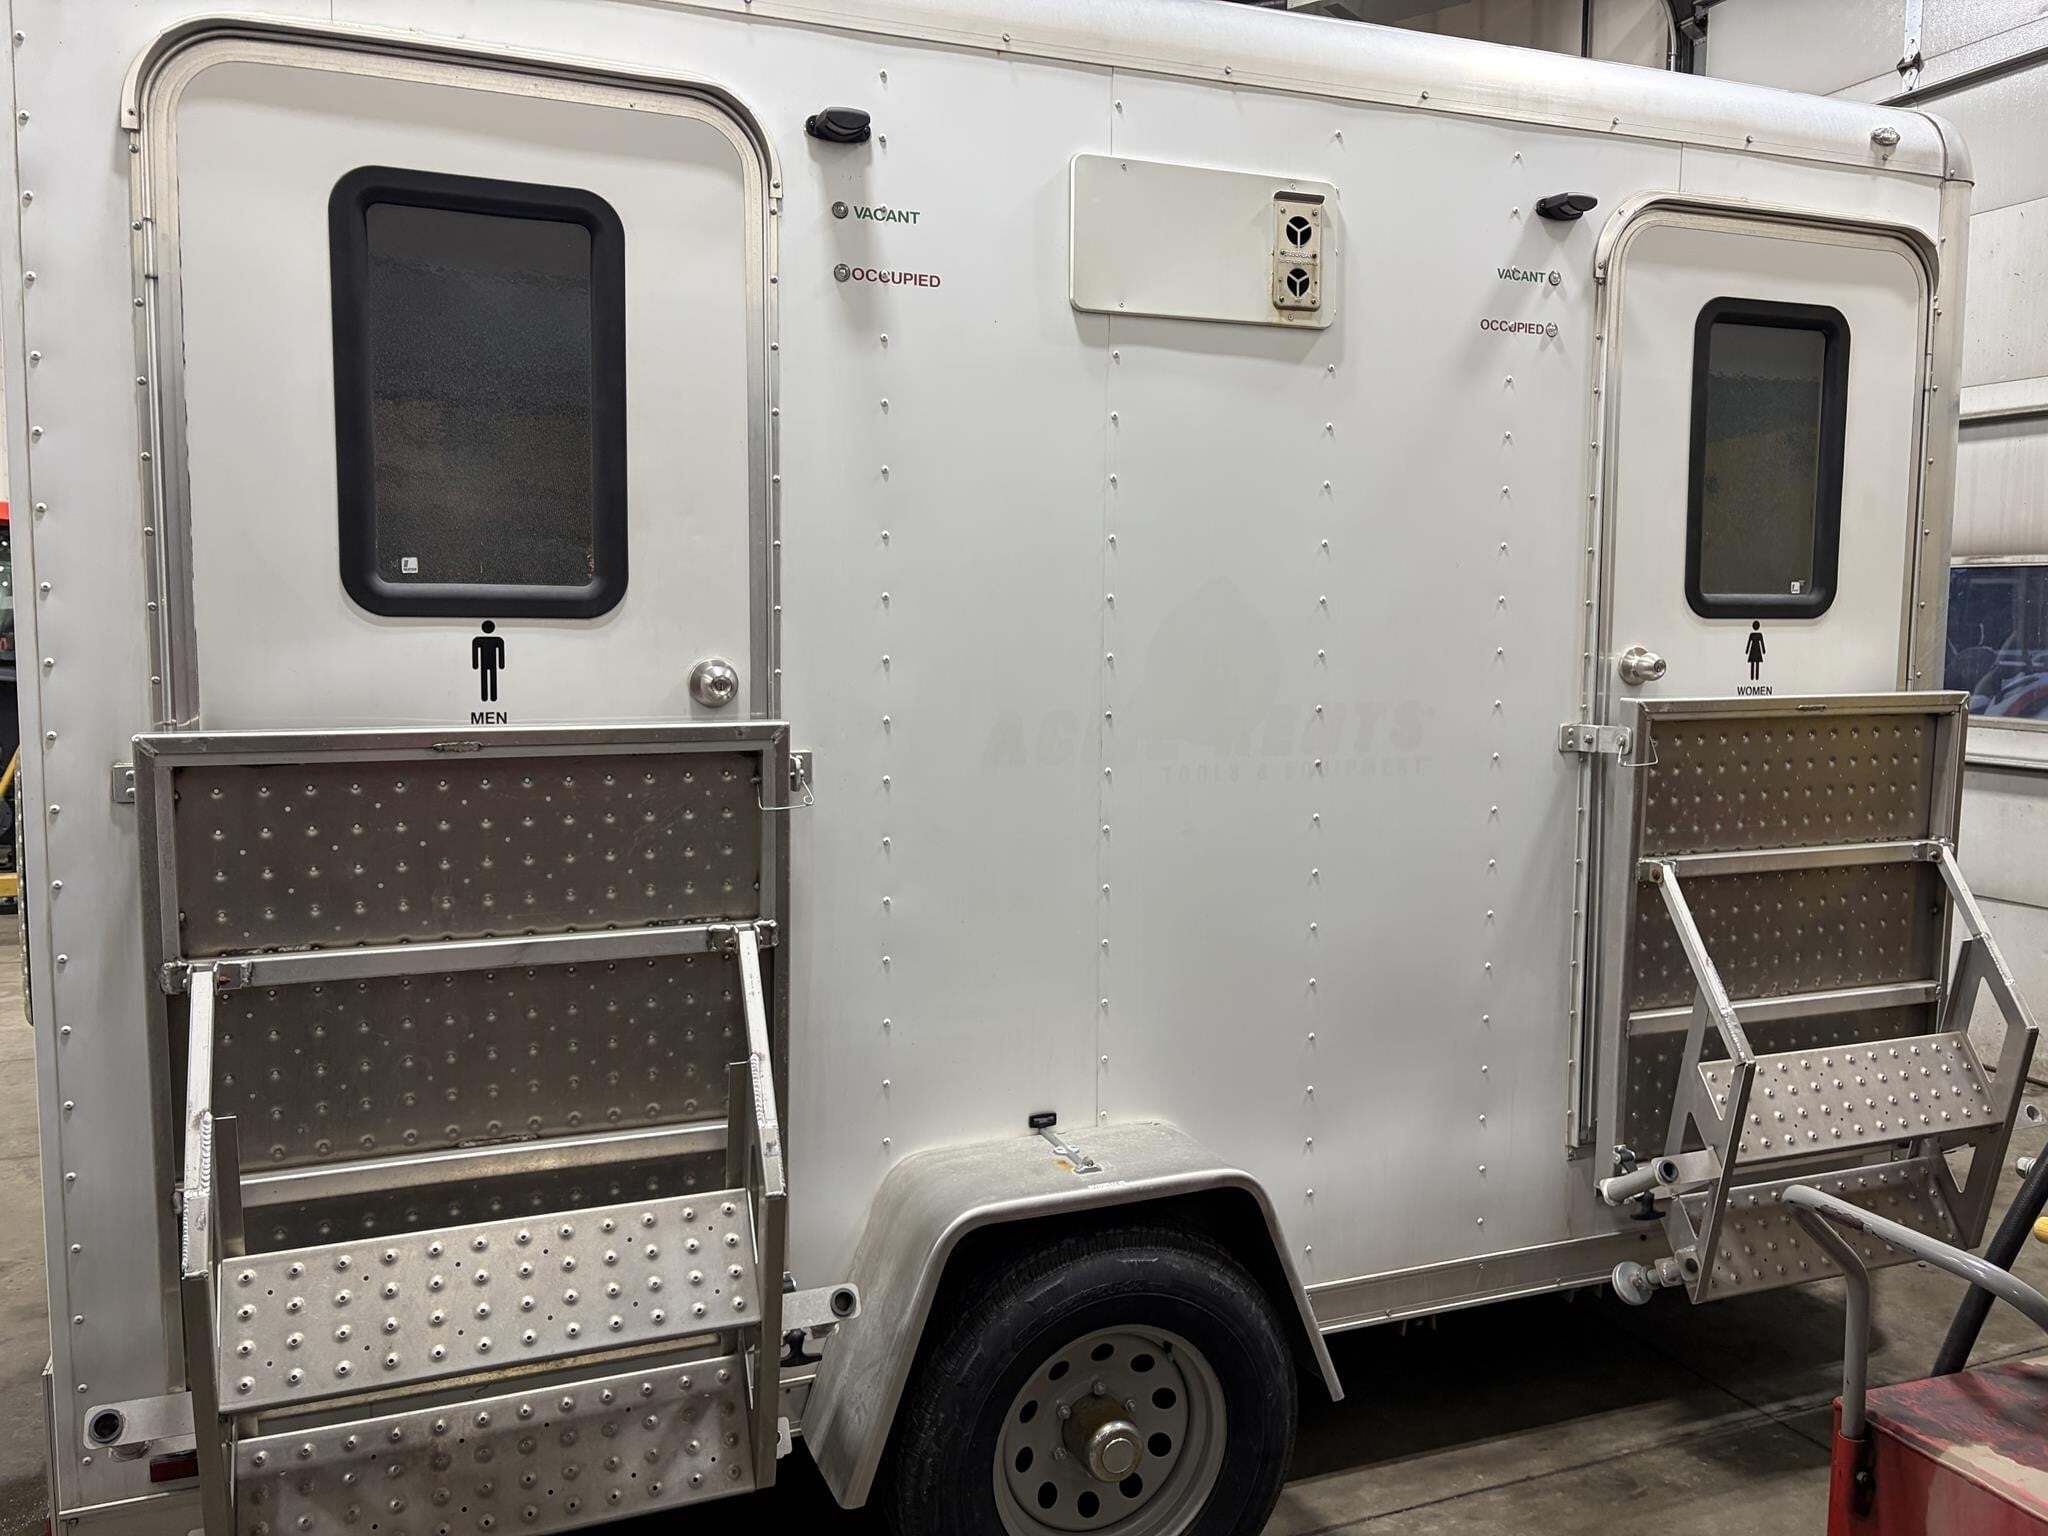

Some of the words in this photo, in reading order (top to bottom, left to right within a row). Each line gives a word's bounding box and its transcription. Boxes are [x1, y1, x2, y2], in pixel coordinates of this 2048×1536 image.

[853, 205, 921, 224] VACANT
[851, 267, 941, 288] OCCUPIED
[1497, 267, 1546, 283] VACANT
[1480, 318, 1545, 335] OCCUPIED
[1737, 686, 1773, 696] WOMEN
[470, 711, 508, 725] MEN
